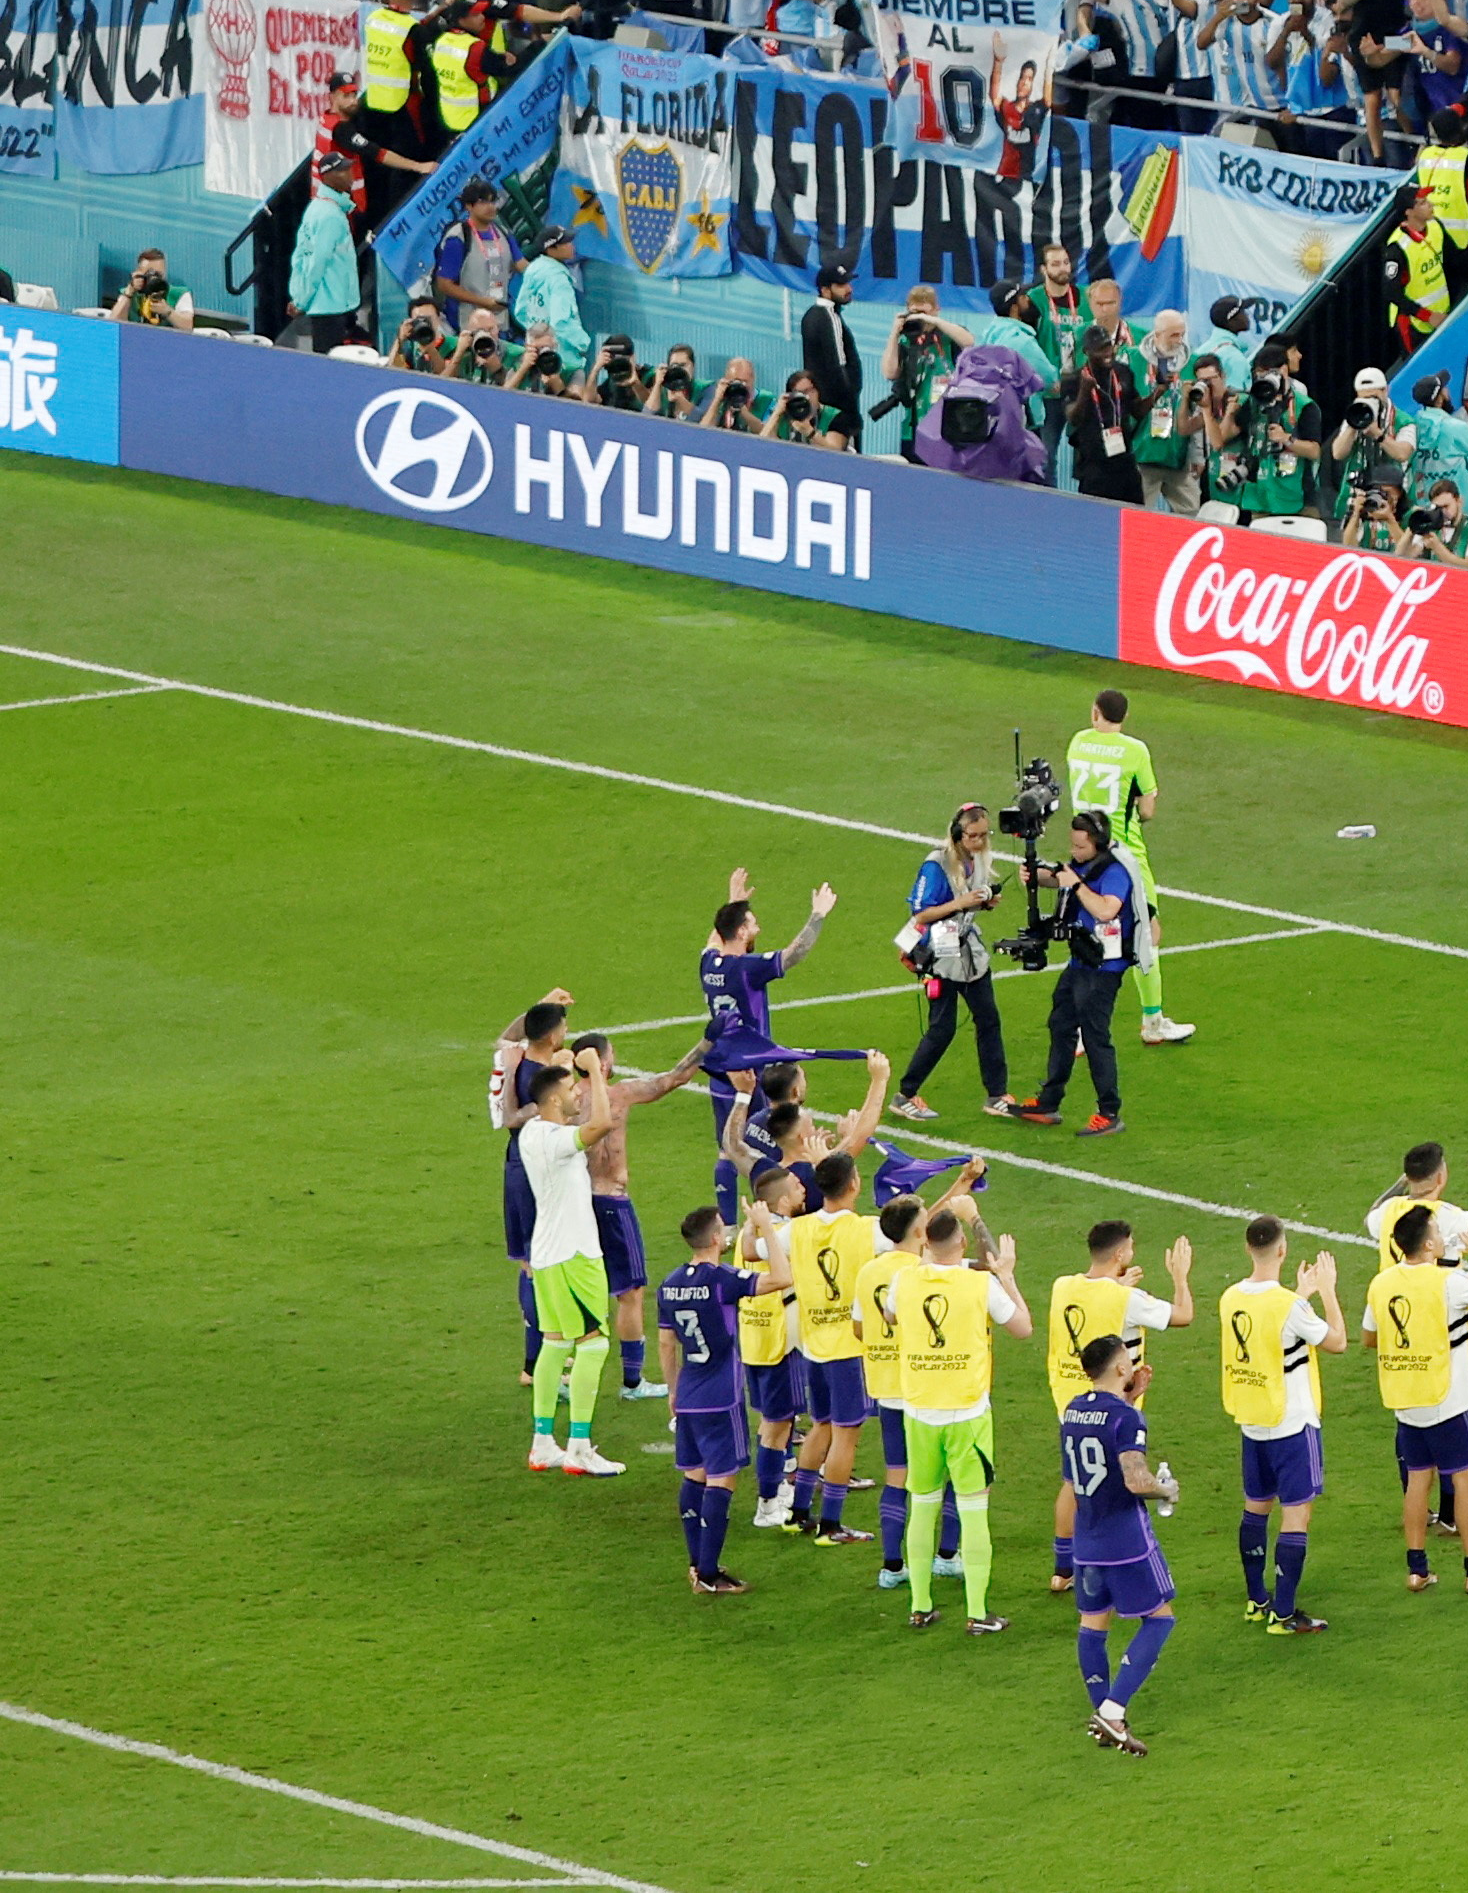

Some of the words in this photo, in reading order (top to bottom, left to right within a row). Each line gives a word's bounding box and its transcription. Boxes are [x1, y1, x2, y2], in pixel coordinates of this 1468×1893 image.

[926, 23, 974, 53] AL
[620, 71, 728, 154] FLORIDA
[913, 57, 987, 148] 10
[515, 424, 871, 579] HYUNDAI
[1155, 526, 1446, 708] Coca-Cola
[1070, 760, 1121, 814] 23
[661, 1285, 710, 1301] TAGLIAFICO
[673, 1308, 712, 1364] 3
[927, 1354, 953, 1363] WORLD
[955, 1353, 972, 1363] CUP
[1065, 1436, 1108, 1497] 19
